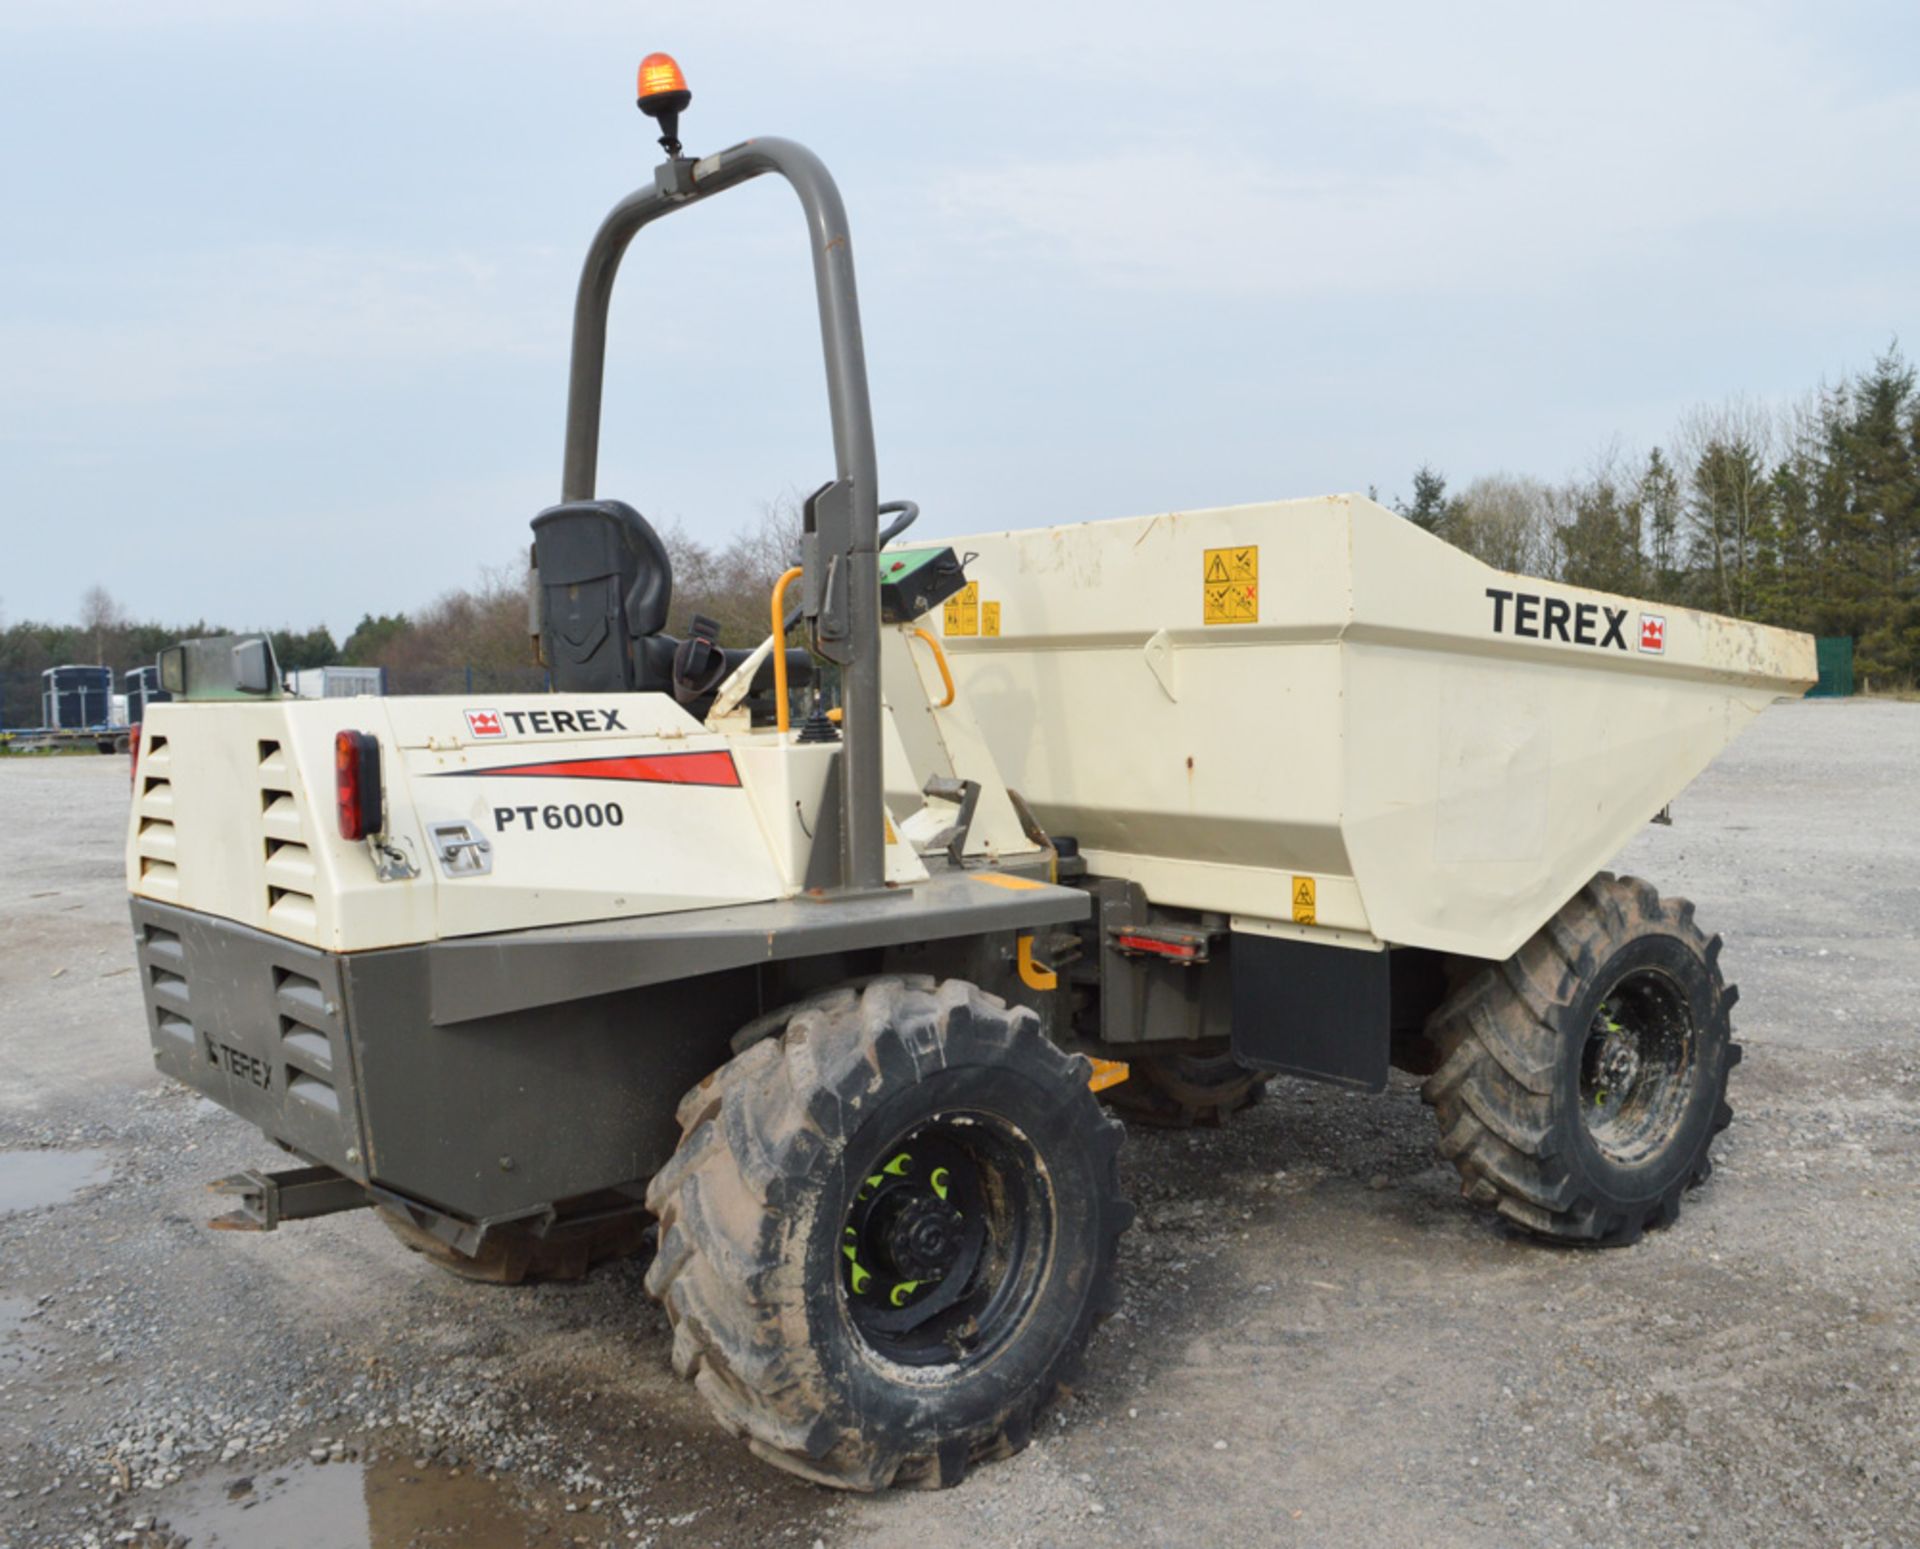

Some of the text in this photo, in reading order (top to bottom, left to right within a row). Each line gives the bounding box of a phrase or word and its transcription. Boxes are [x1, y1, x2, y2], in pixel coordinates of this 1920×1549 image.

[1485, 588, 1628, 650] TEREX
[504, 709, 627, 735] TEREX
[494, 802, 624, 832] PT6000
